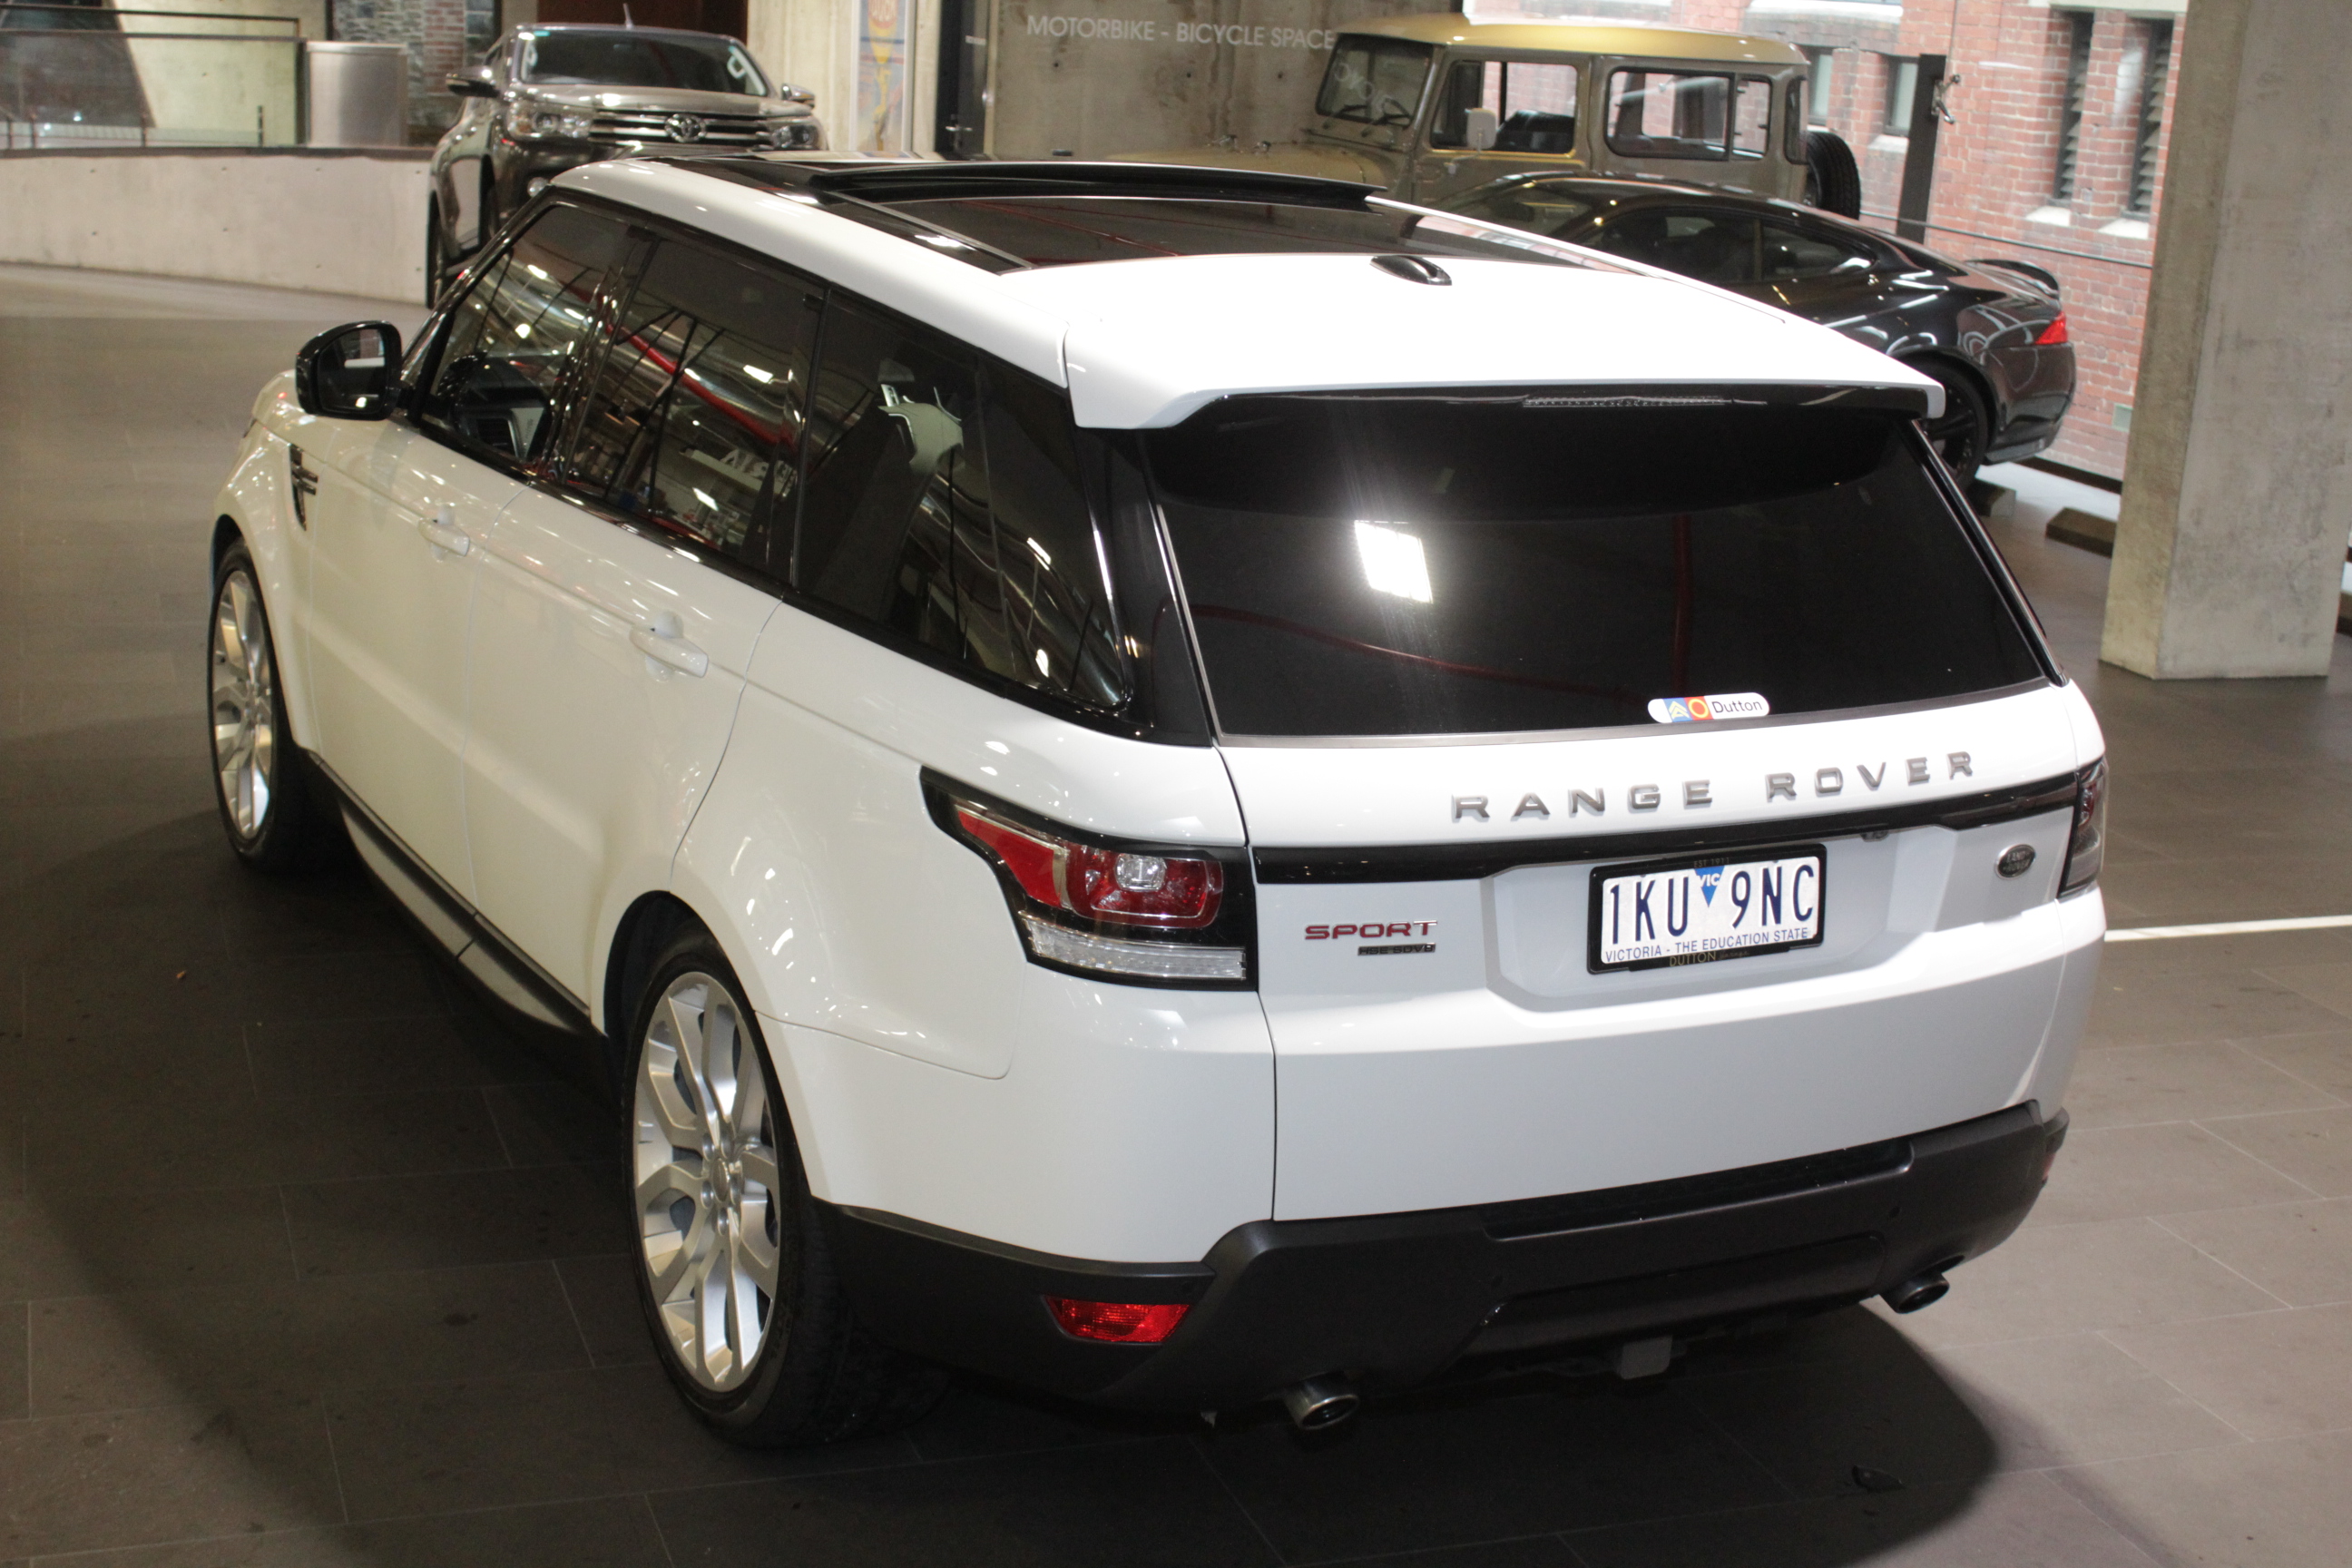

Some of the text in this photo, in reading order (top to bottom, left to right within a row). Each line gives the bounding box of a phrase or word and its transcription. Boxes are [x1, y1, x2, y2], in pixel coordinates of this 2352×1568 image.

[1026, 15, 1155, 42] MOTORBIKE
[1176, 22, 1265, 46] BICYCLE
[1270, 26, 1336, 50] SPACE
[1711, 700, 1763, 714] Dutton
[1452, 750, 1974, 818] RANGE ROVER
[1696, 872, 1722, 887] VIC
[1610, 864, 1815, 946] 1KU 9NC
[1304, 920, 1437, 940] SPORT
[1358, 946, 1388, 956] HSE
[1605, 945, 1662, 963] VICTORIA
[1675, 940, 1699, 954] THE
[1702, 931, 1770, 951] EDUCATION
[1774, 927, 1808, 942] STATE
[1670, 950, 1717, 967] DUTTON
